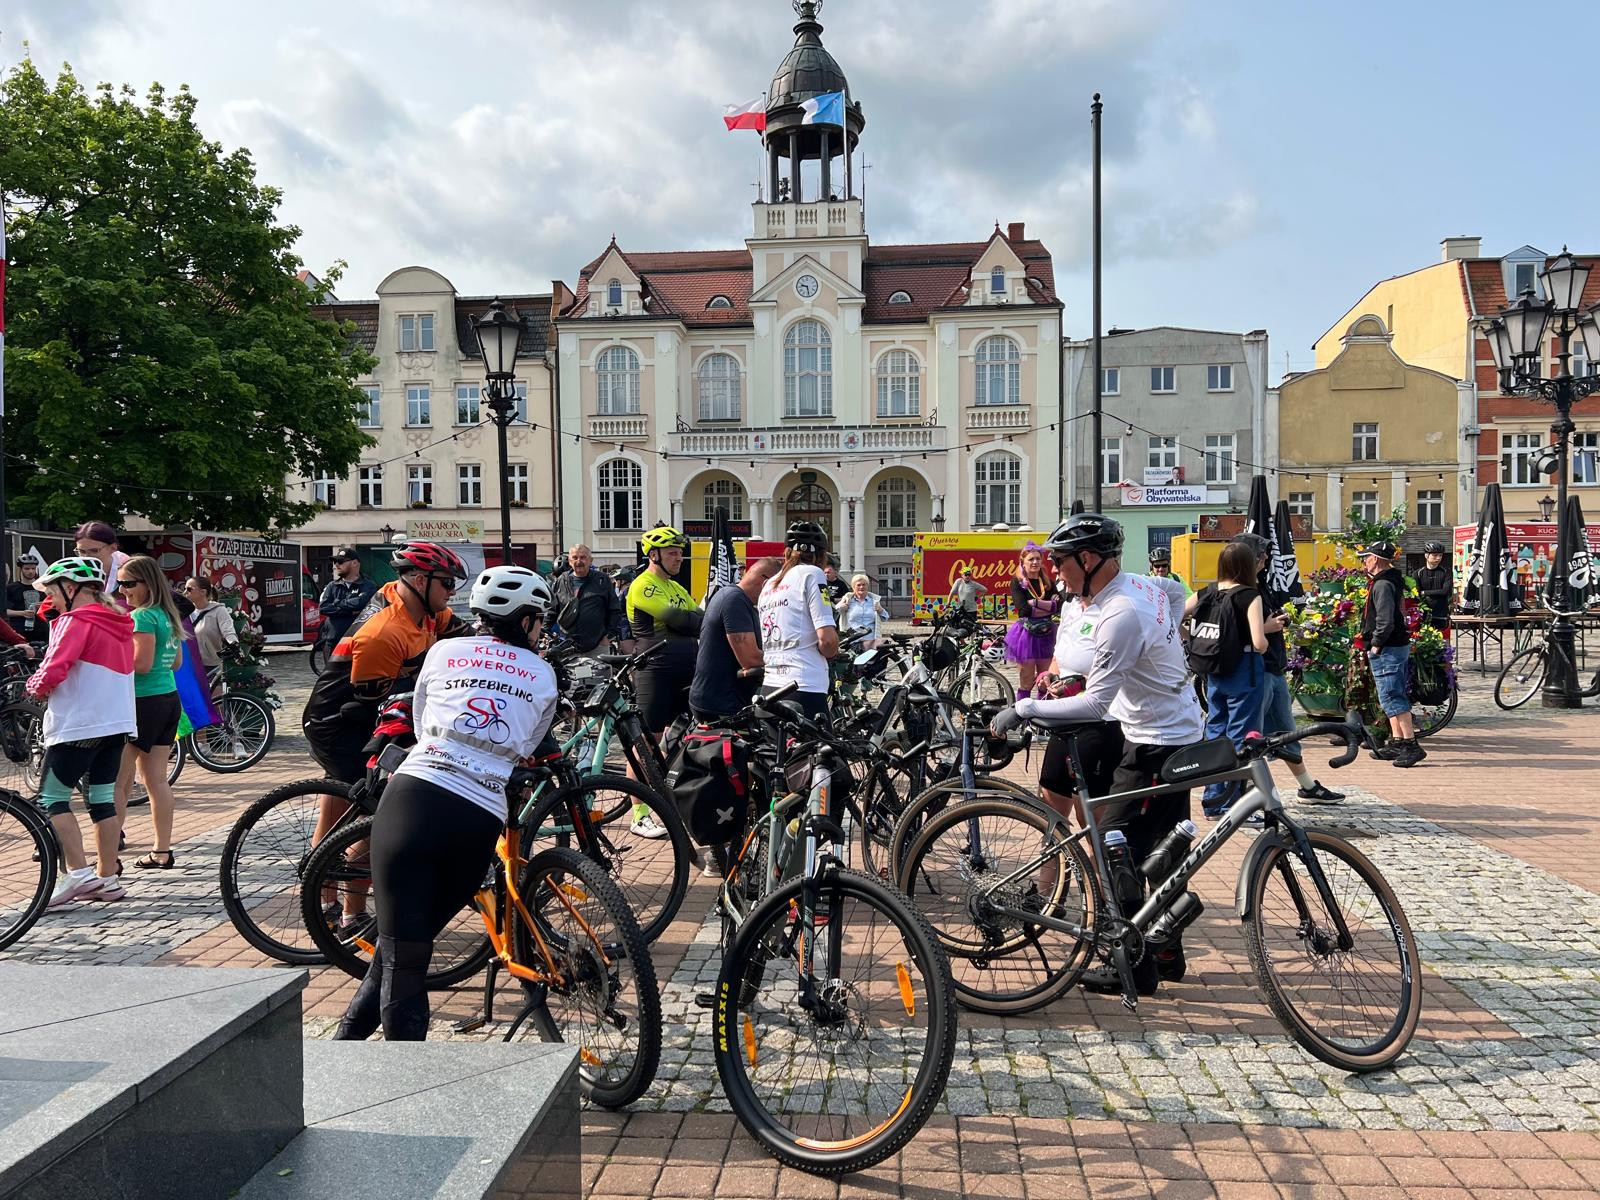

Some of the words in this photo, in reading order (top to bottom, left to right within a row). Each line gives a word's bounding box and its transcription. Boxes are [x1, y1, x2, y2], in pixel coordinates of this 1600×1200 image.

[1146, 488, 1189, 496] Platforma
[1146, 494, 1201, 504] Obywatelska
[414, 521, 461, 530] MAKARON
[411, 530, 416, 538] Z
[445, 530, 464, 538] SERA
[929, 536, 959, 547] Churros
[1190, 617, 1221, 639] VANS
[474, 645, 517, 661] KLUB
[447, 657, 537, 682] ROWEROWY
[1393, 923, 1408, 953] R500
[718, 982, 729, 1053] MAXXIS
